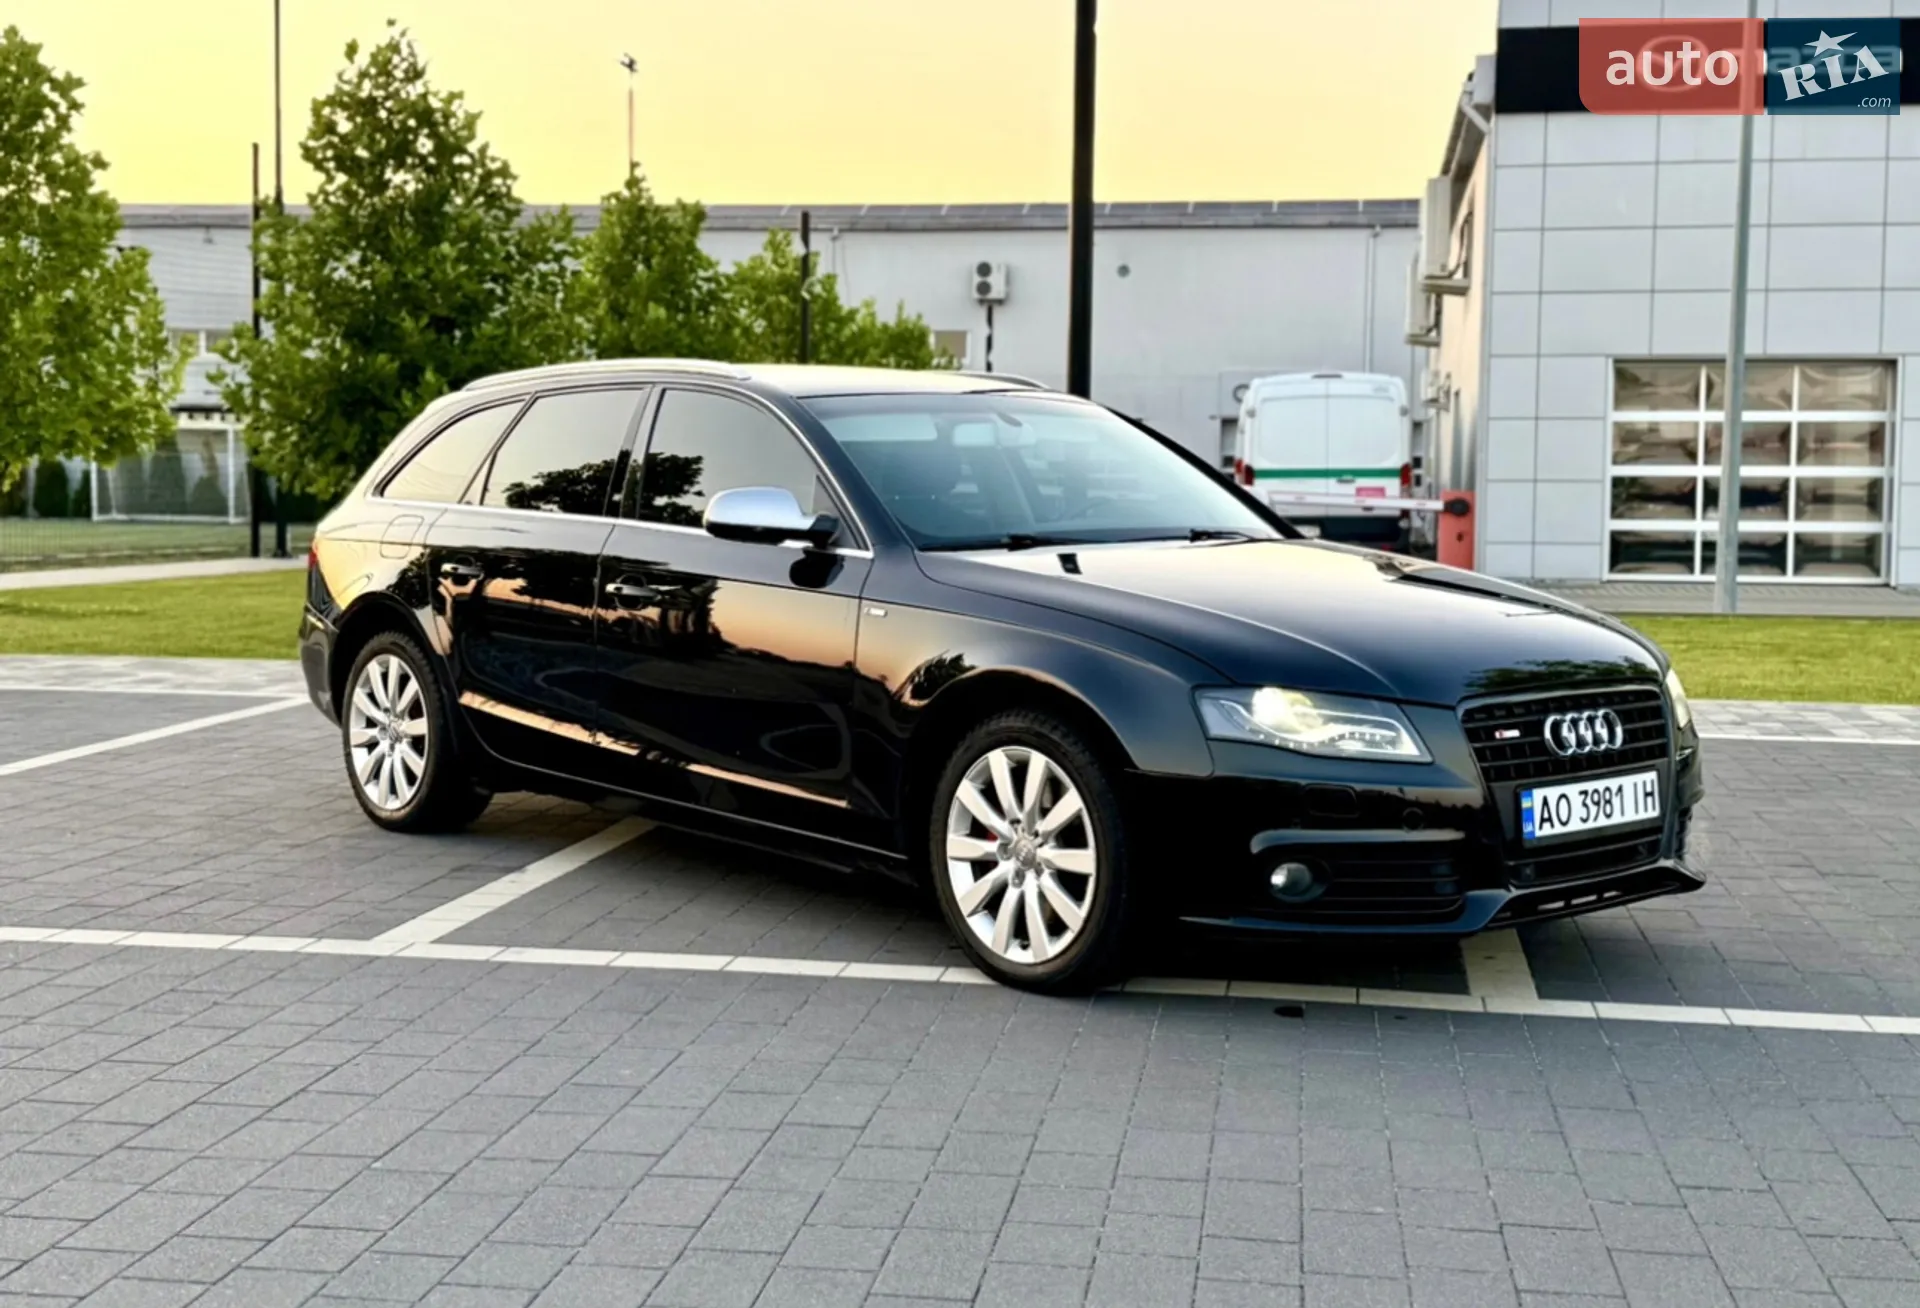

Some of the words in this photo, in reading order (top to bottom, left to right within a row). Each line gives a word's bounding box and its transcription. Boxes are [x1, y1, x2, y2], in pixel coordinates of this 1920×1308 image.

[1539, 793, 1572, 831] AO
[1578, 784, 1625, 823] 3981
[1633, 778, 1657, 815] IH
